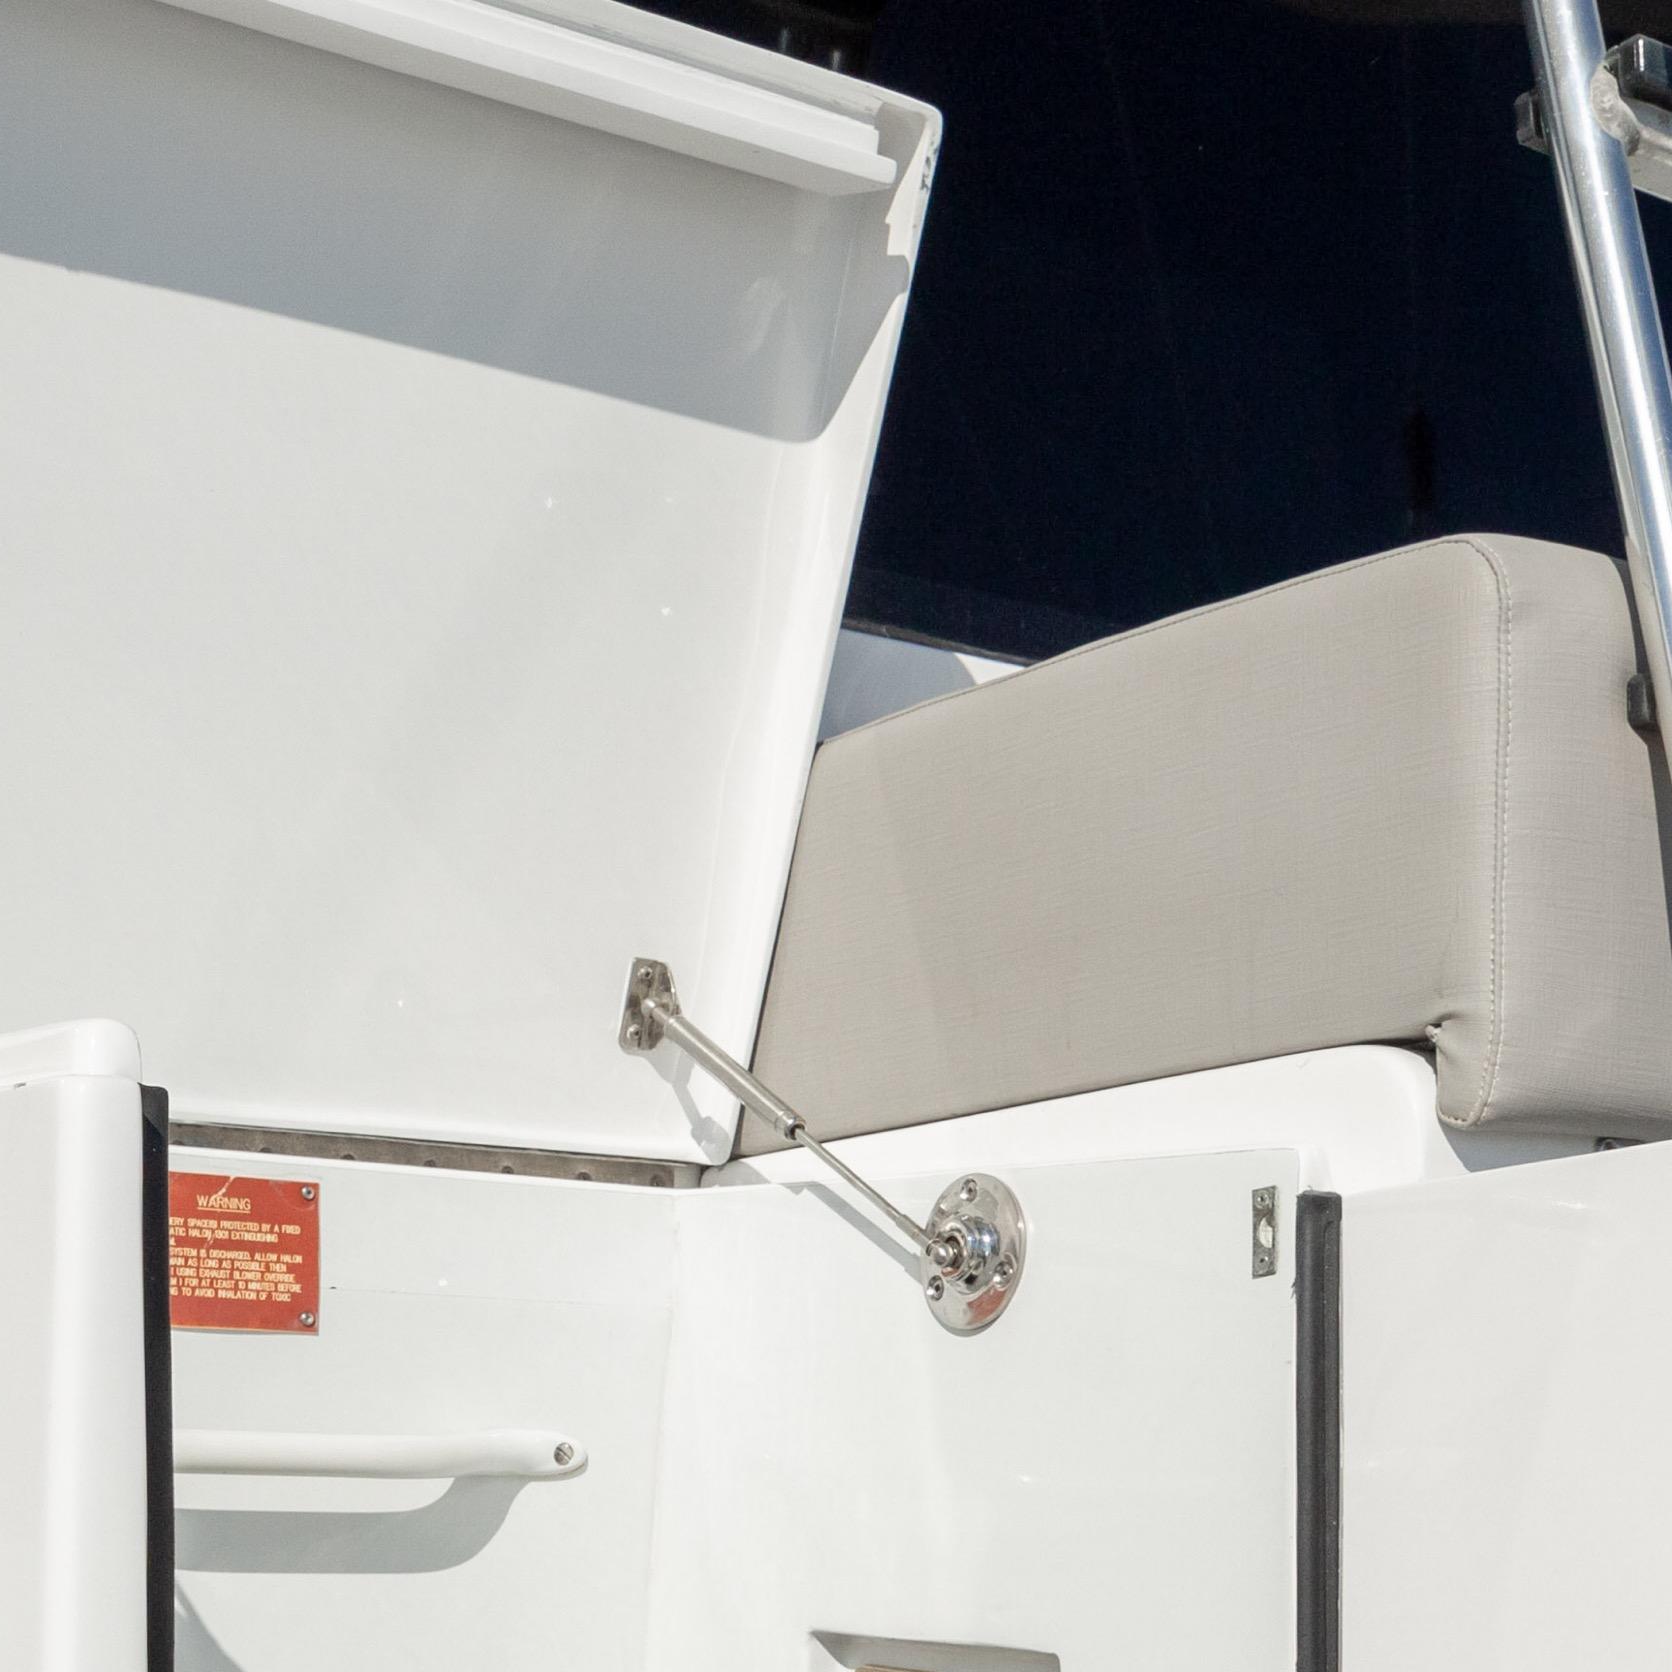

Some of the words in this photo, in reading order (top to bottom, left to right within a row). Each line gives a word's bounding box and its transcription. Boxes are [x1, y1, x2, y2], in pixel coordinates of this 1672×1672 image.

[197, 1194, 251, 1210] WARNING
[220, 1220, 260, 1232] PROTECTED
[261, 1223, 271, 1232] BY
[281, 1224, 301, 1235] FIXED
[187, 1258, 198, 1267] AS
[200, 1258, 219, 1268] LONG
[221, 1260, 232, 1269] AS
[233, 1260, 266, 1272] POSSIBLE
[269, 1262, 287, 1273] THEN
[254, 1252, 278, 1262] ALLOW
[280, 1253, 303, 1264] HALON
[184, 1277, 199, 1287] FOR
[201, 1278, 211, 1287] AT
[213, 1279, 236, 1289] LEAST
[181, 1286, 192, 1296] TO
[194, 1287, 215, 1297] AVOID
[217, 1288, 257, 1300] INHALATION
[258, 1291, 269, 1301] OF
